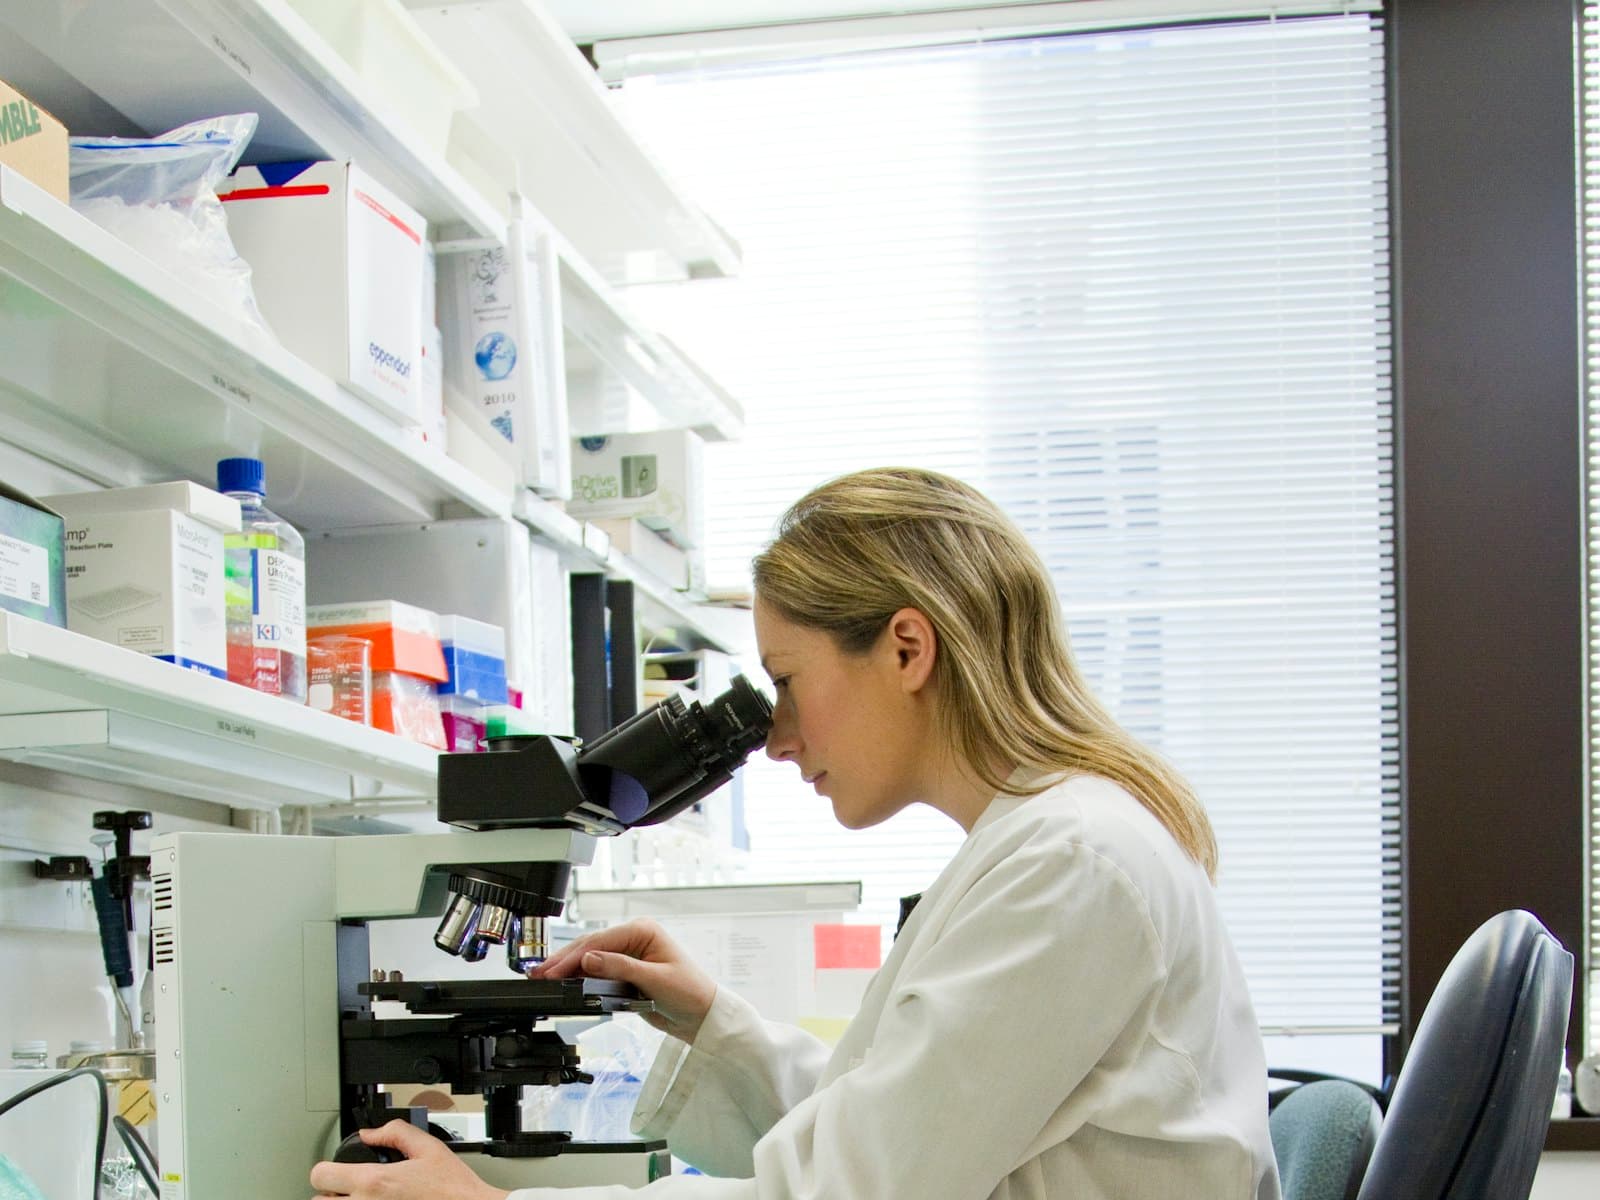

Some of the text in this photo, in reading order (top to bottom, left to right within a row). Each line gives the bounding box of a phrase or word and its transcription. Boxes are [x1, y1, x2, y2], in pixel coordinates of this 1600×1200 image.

[369, 341, 411, 379] eppendorf
[483, 393, 516, 406] 2010
[68, 862, 76, 874] 3
